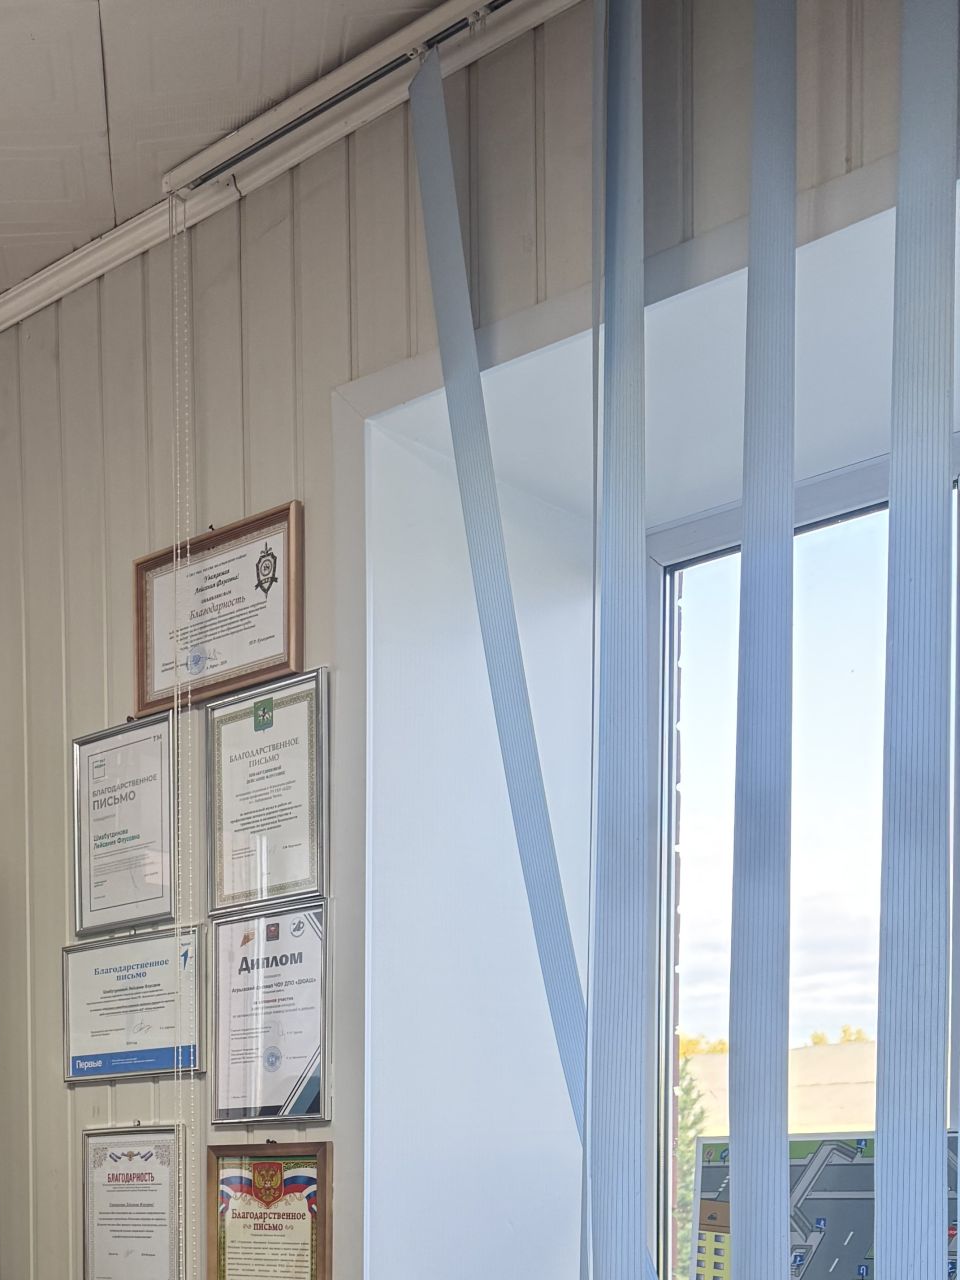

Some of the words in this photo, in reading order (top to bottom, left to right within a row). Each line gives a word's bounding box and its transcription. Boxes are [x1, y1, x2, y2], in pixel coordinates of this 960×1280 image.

[190, 596, 246, 620] Благодарность
[229, 737, 300, 763] БЛАГОДАРСТВЕННОЕ
[249, 753, 280, 768] ПИСЬМО
[92, 773, 158, 798] БЛАГОДАРСТВЕННОЕ
[92, 790, 136, 811] ПИСЬМО
[94, 958, 170, 976] Благодарственное
[238, 951, 303, 975] Диплом
[116, 971, 147, 981] письмо
[76, 1059, 103, 1071] Первые
[107, 1172, 155, 1183] БЛАГОДАРНОСТЬ
[231, 1208, 306, 1223] Благодарственное
[253, 1223, 283, 1231] письмо
